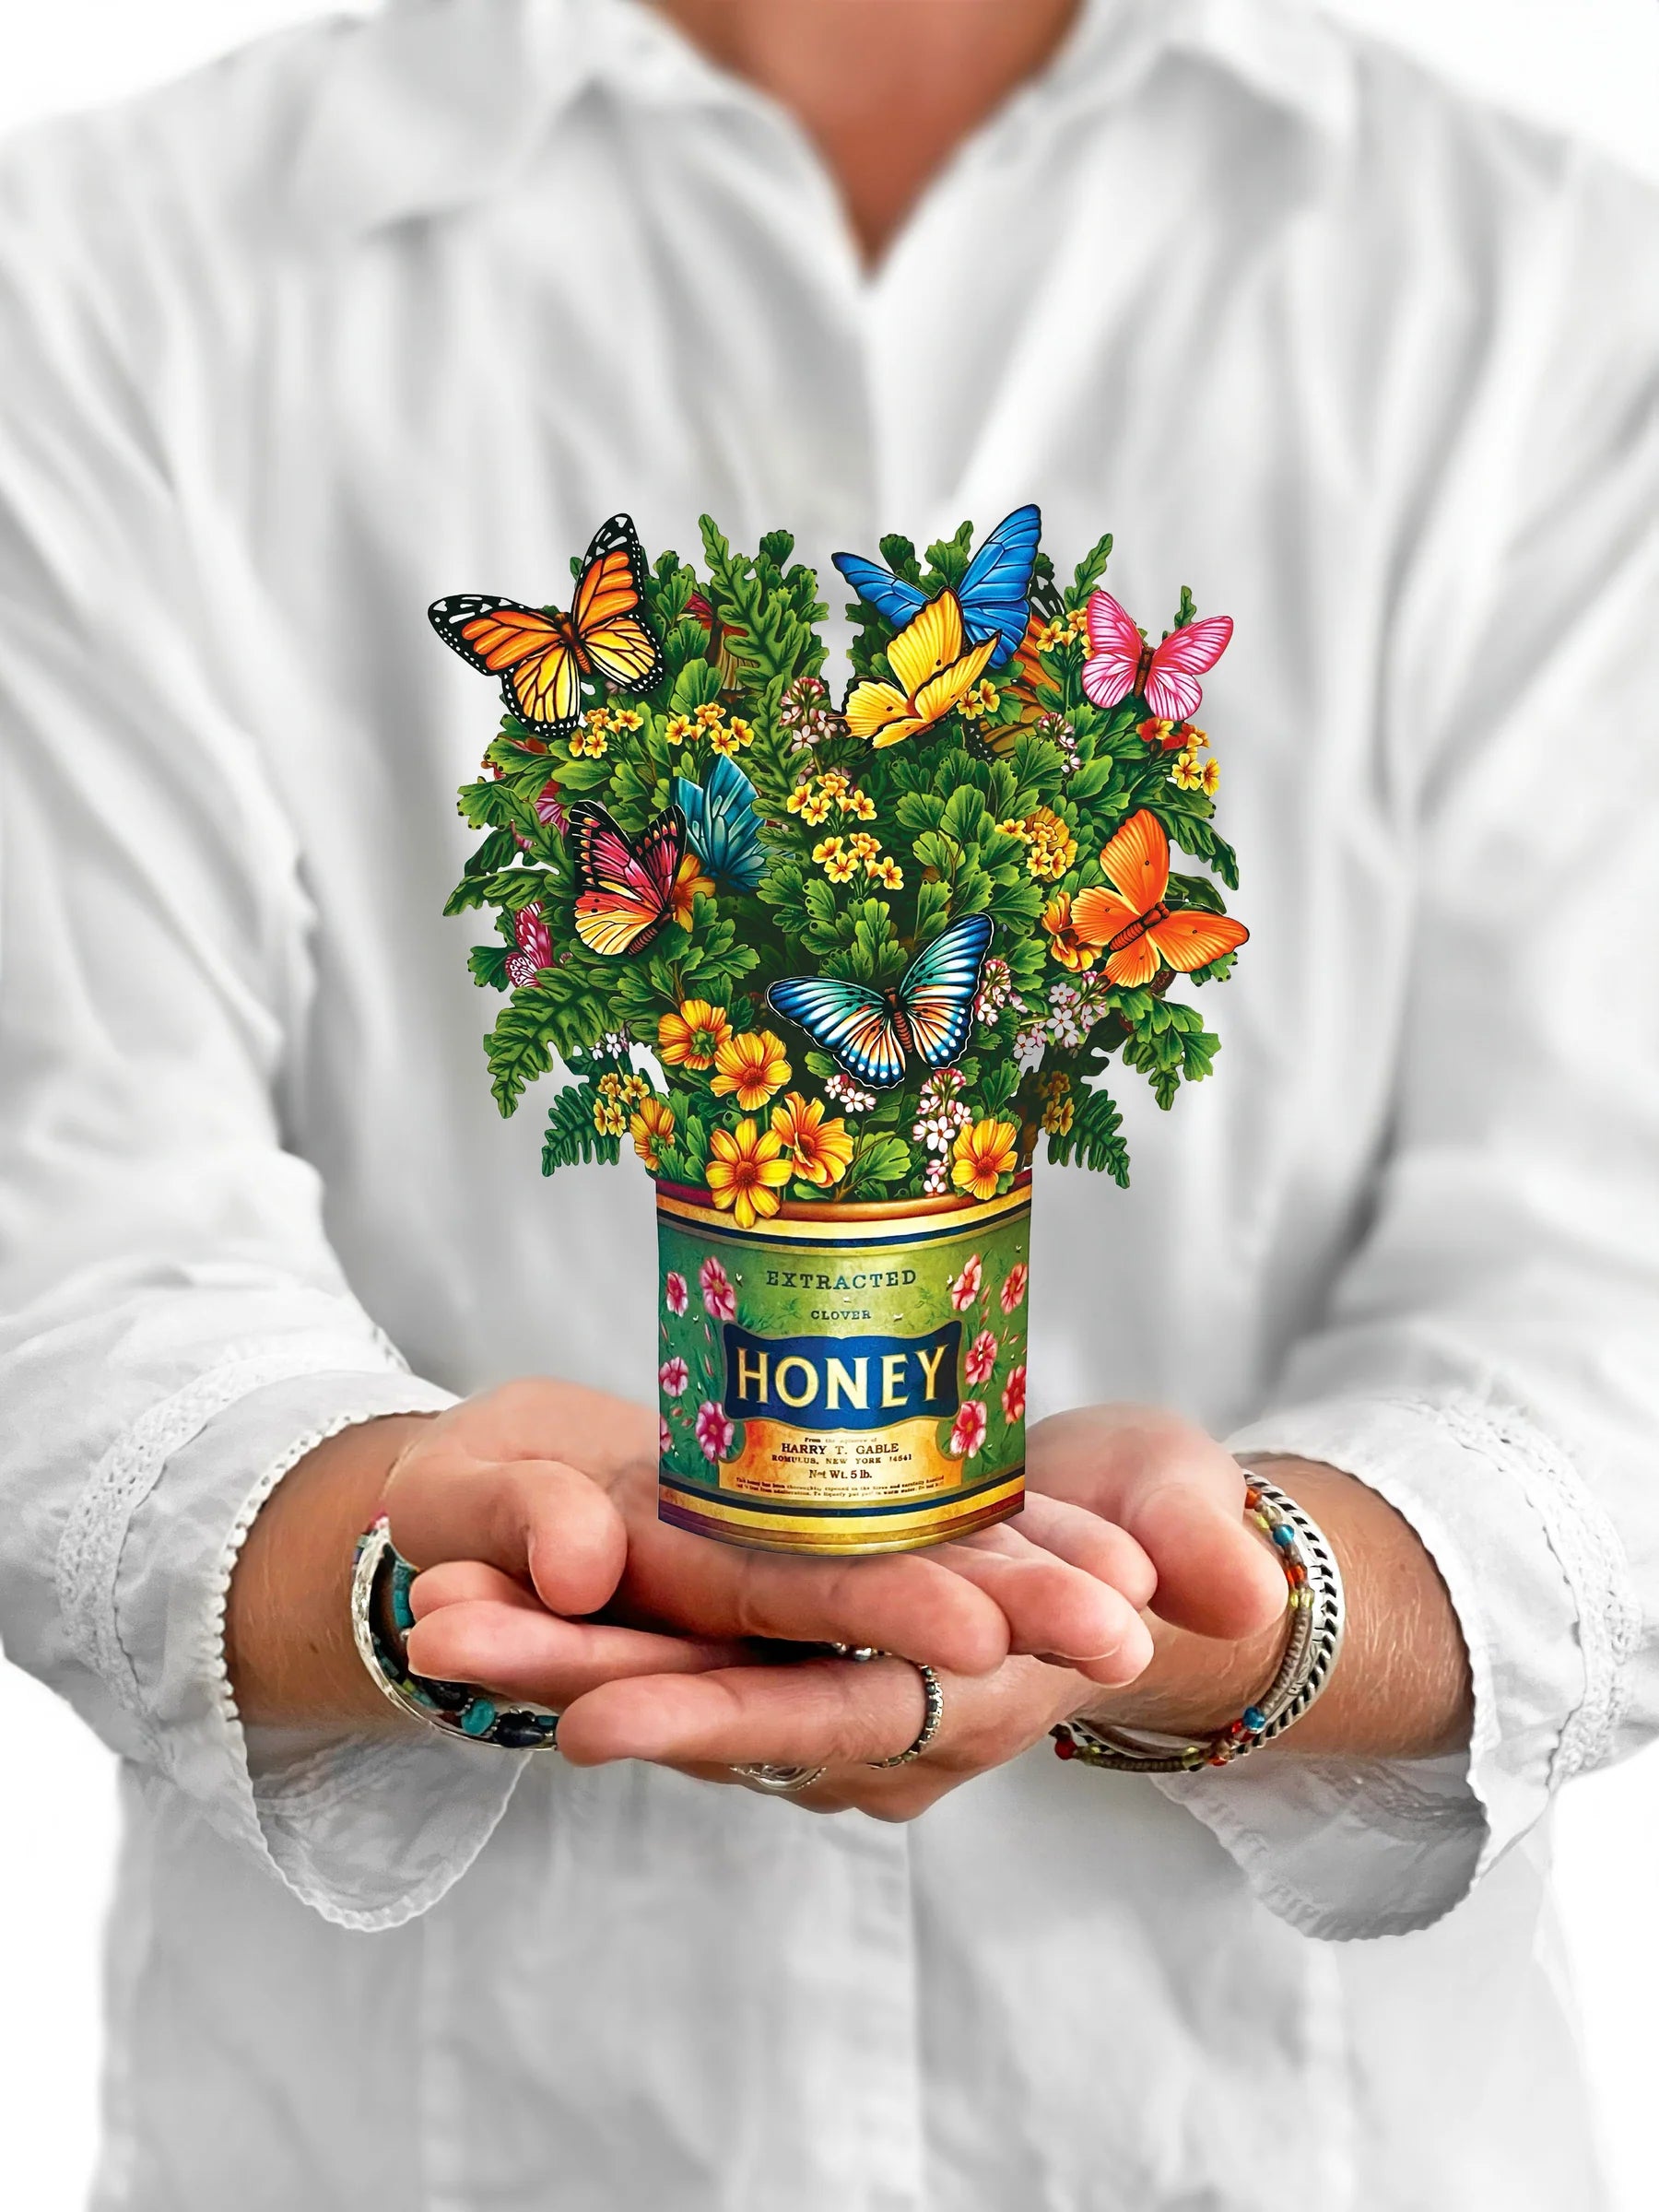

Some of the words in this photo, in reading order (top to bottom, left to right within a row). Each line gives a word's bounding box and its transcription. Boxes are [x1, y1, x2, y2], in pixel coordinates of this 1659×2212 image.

[766, 1269, 916, 1289] EXTRACTED
[810, 1310, 872, 1321] CLOVER
[735, 1344, 949, 1410] HONEY
[782, 1442, 827, 1454] HARRY
[835, 1445, 848, 1454] T.
[856, 1442, 900, 1454] GABLE
[830, 1469, 848, 1478] Wt.
[851, 1469, 857, 1478] 5
[860, 1469, 873, 1478] lb.
